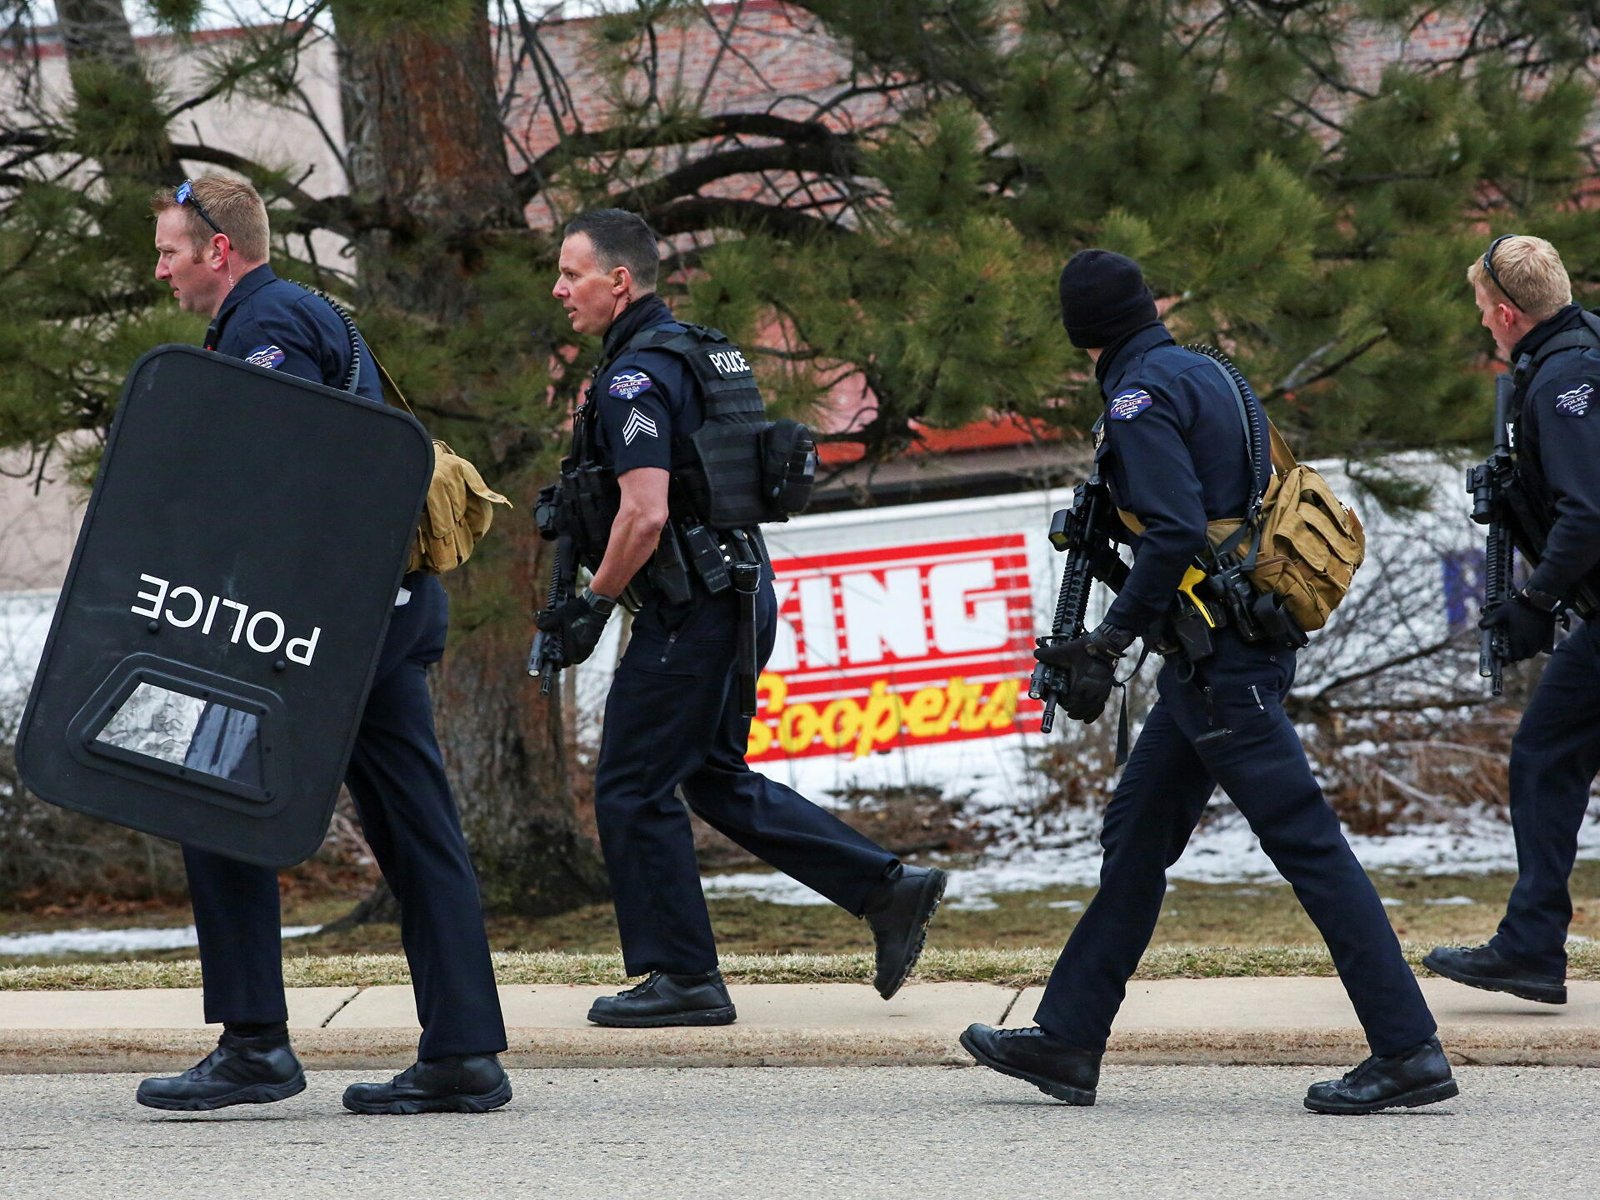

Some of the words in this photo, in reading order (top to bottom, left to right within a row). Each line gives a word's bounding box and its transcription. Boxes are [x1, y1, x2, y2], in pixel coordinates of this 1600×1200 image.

[708, 351, 750, 374] POLICE
[616, 381, 642, 390] POLICE
[1115, 399, 1142, 412] POLICE
[1563, 394, 1589, 408] POLICE
[130, 573, 322, 667] POLICE
